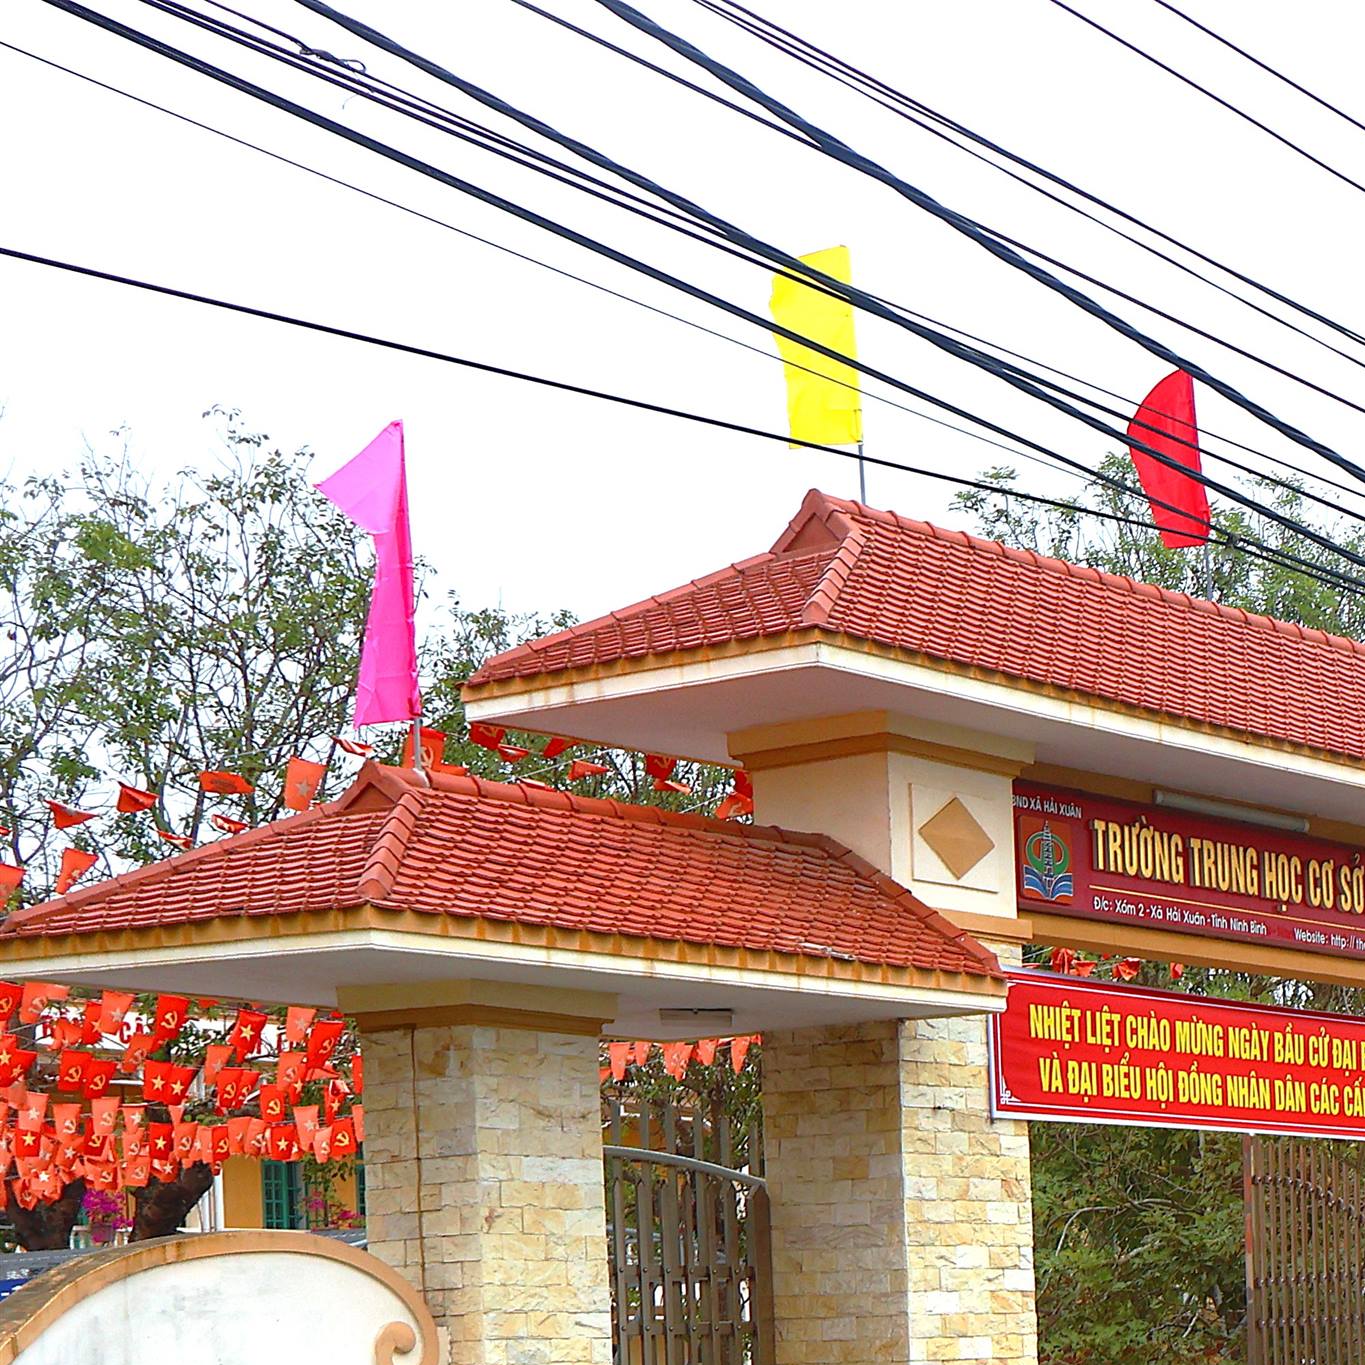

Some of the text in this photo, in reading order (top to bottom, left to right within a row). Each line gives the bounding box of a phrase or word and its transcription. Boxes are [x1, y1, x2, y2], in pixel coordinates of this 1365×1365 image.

[1092, 815, 1184, 884] TRƯỜNG
[1189, 837, 1258, 896] TRUNG
[1262, 851, 1302, 912] HỌC
[1307, 858, 1334, 910] CƠ
[1339, 853, 1365, 915] SỞ
[1115, 899, 1136, 916] Xóm
[1166, 906, 1181, 922] Hải
[1230, 917, 1248, 933] Ninh
[1250, 920, 1267, 935] Bình
[1294, 927, 1328, 945] Website:
[1029, 1000, 1082, 1049] NHIỆT
[1086, 1005, 1121, 1053] LIỆT
[1125, 1010, 1171, 1052] CHÀO
[1175, 1015, 1224, 1057] MỪNG
[1228, 1022, 1271, 1062] NGÀY
[1274, 1022, 1304, 1066] BẦU
[1309, 1026, 1330, 1068] CỬ
[1332, 1038, 1357, 1076] ĐẠI
[1038, 1051, 1064, 1093] VÀ
[1067, 1060, 1098, 1103] ĐẠI
[1101, 1051, 1141, 1100] BIỂU
[1145, 1061, 1174, 1109] HỘI
[1178, 1060, 1223, 1107] ĐỒNG
[1226, 1071, 1271, 1111] NHÂN
[1274, 1074, 1307, 1113] DÂN
[1310, 1078, 1339, 1116] CÁC
